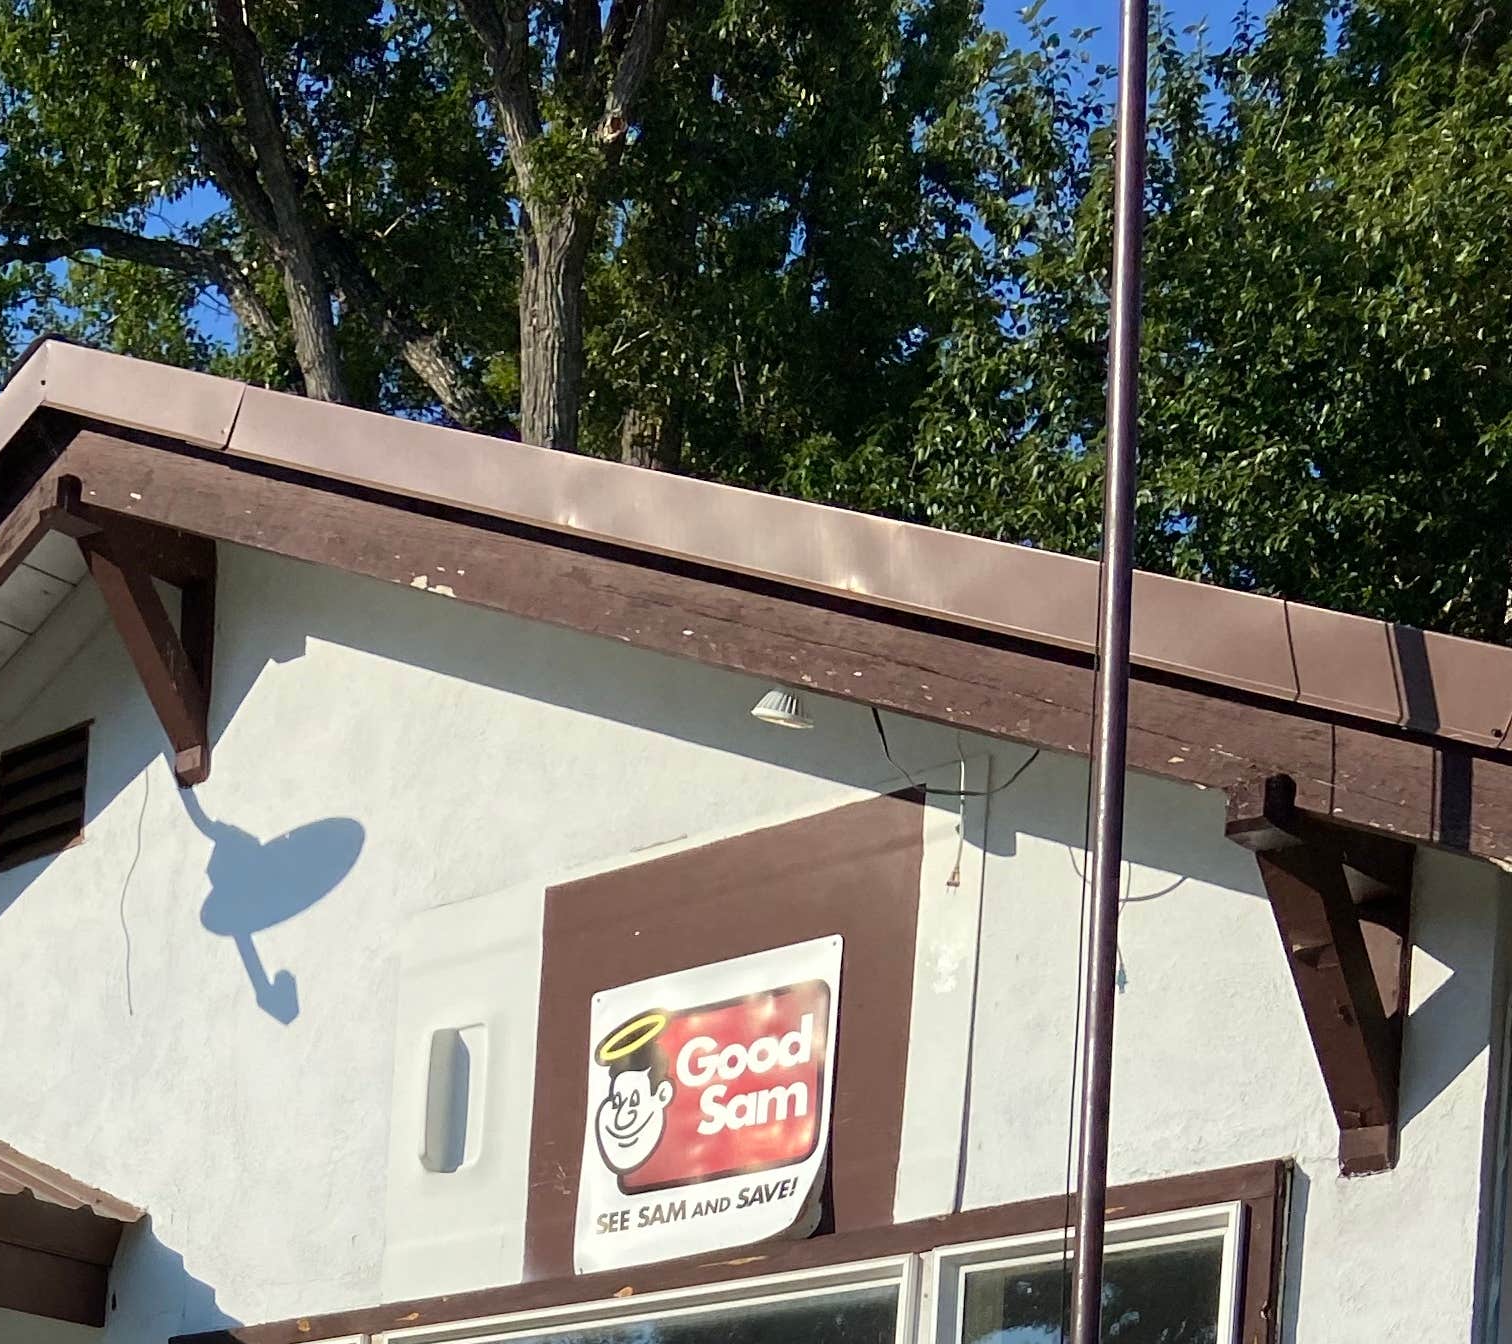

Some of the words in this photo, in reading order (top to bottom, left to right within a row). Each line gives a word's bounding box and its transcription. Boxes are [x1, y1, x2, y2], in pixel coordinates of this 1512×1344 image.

[676, 1013, 814, 1087] Good
[697, 1082, 808, 1135] Sam
[596, 1210, 630, 1235] SEE
[637, 1200, 687, 1227] SAM
[691, 1197, 731, 1218] AND
[737, 1178, 798, 1209] SAVE!
